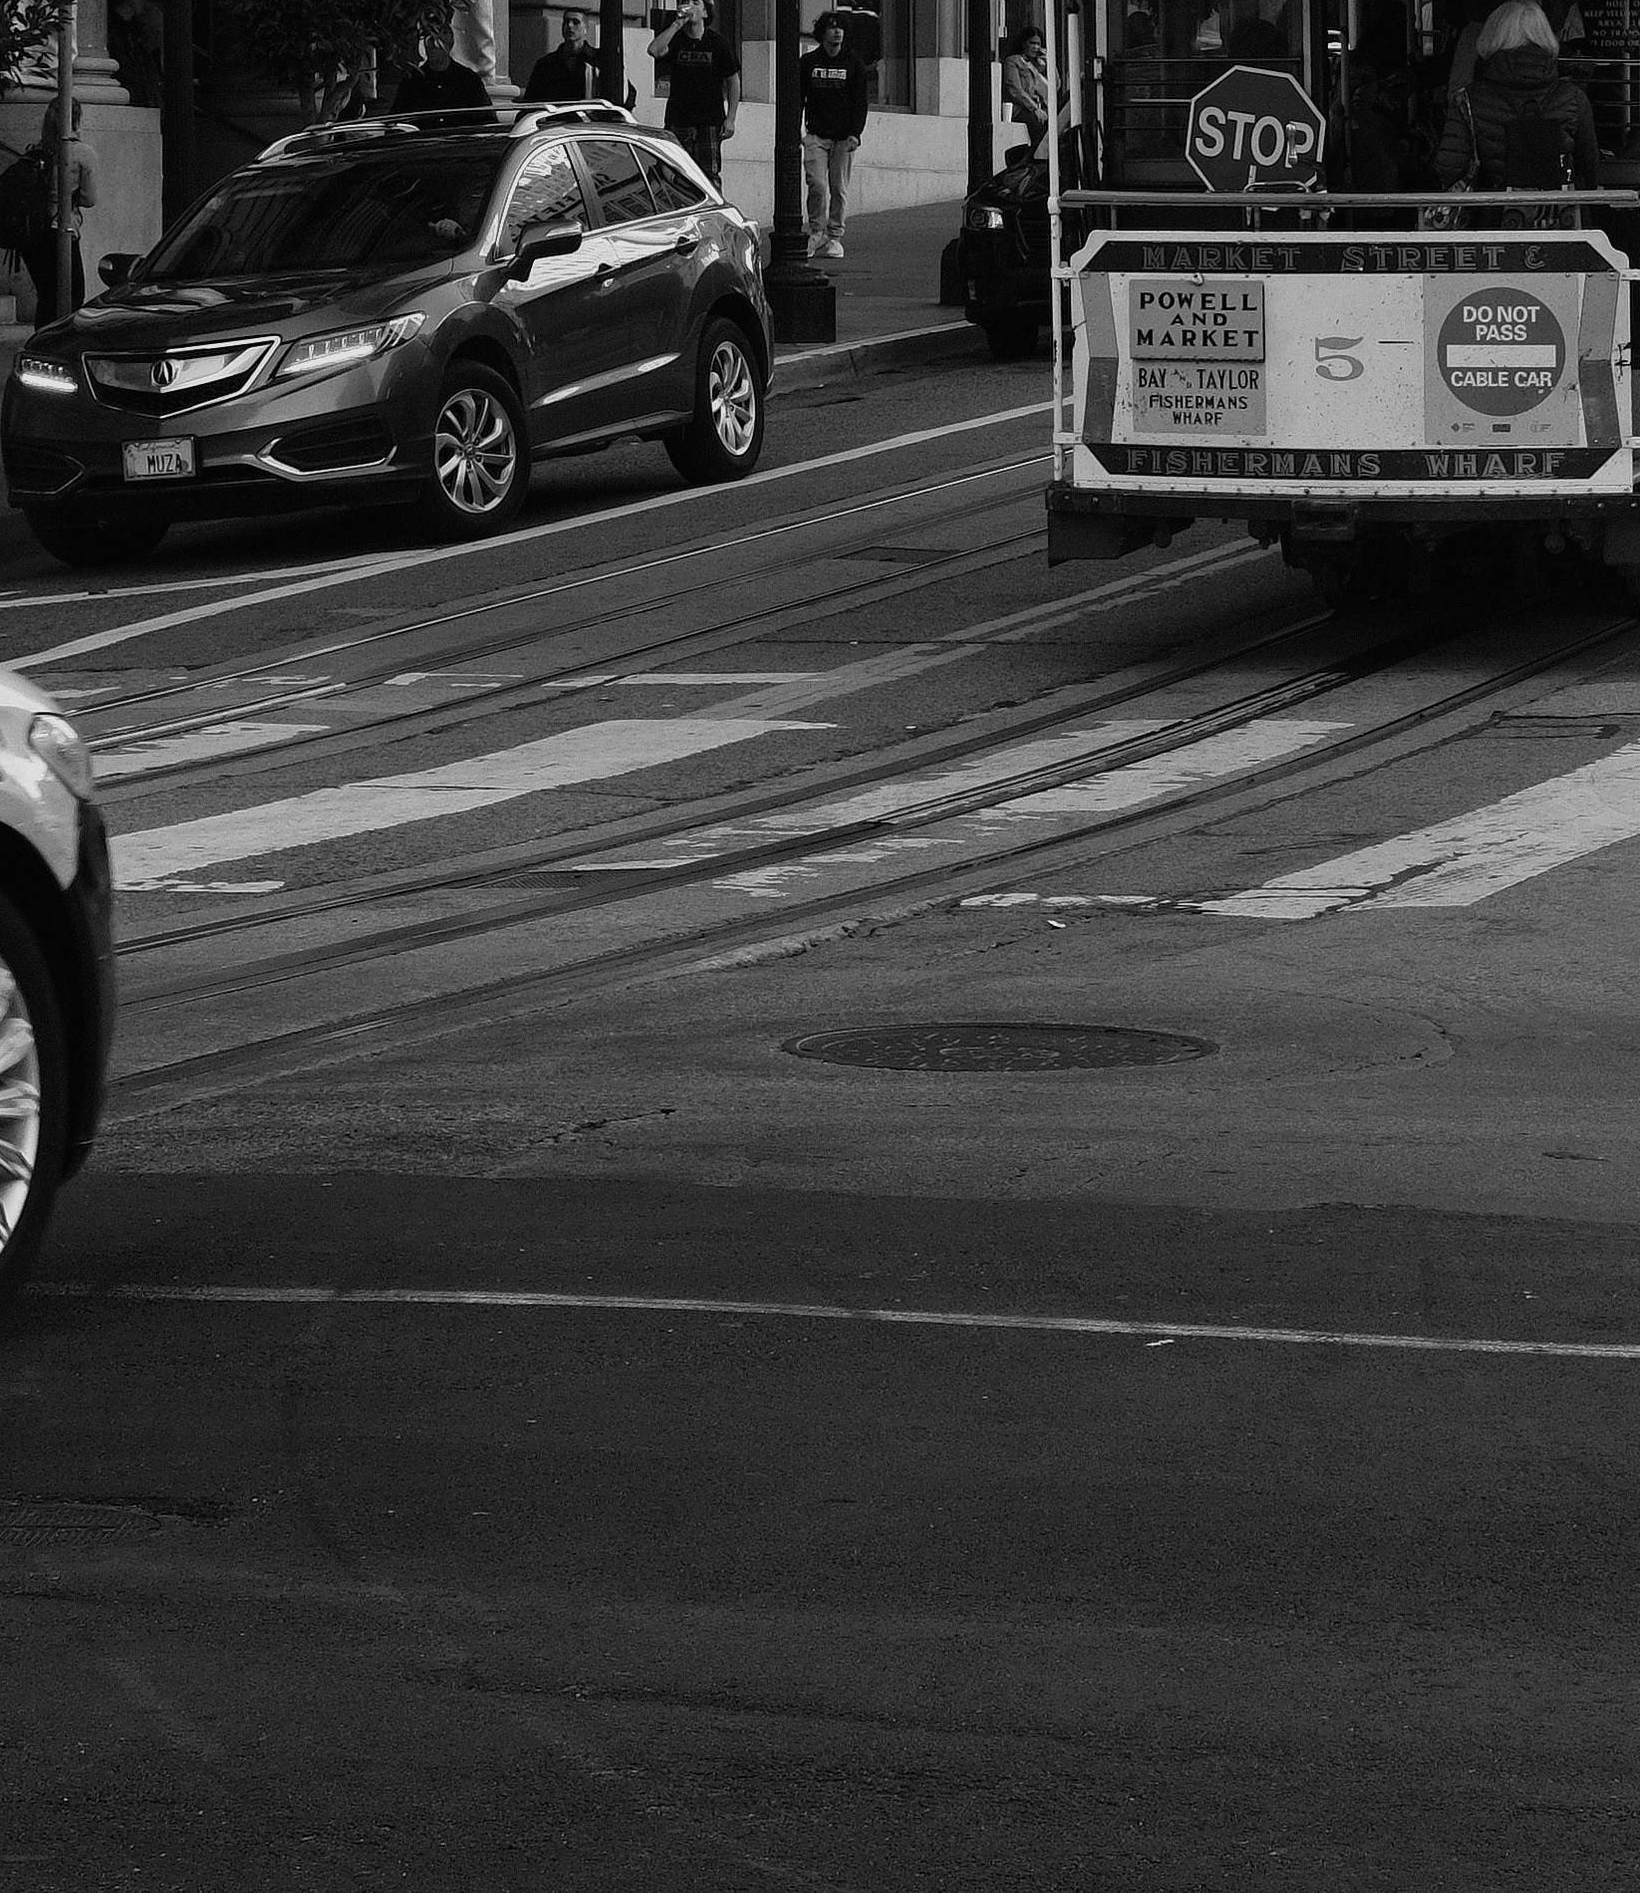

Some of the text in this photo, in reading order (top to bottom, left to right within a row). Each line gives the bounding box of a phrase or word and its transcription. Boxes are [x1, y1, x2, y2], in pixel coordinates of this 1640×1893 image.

[1195, 106, 1315, 168] STOP
[1141, 245, 1302, 272] MARKET
[1341, 245, 1506, 272] STREET
[1140, 291, 1258, 311] POWELL
[1170, 312, 1227, 326] AND
[1463, 306, 1540, 323] DO NOT
[1137, 328, 1259, 347] MARKET
[1475, 324, 1527, 341] PASS
[1315, 336, 1364, 382] 5
[1138, 367, 1167, 388] BAY
[1197, 368, 1259, 390] TAYLOR
[1450, 371, 1552, 387] CABLE CAR
[1149, 395, 1248, 410] FISHERMANS
[1172, 411, 1223, 425] WHARF
[1125, 448, 1566, 478] FISHERMANS WHARF
